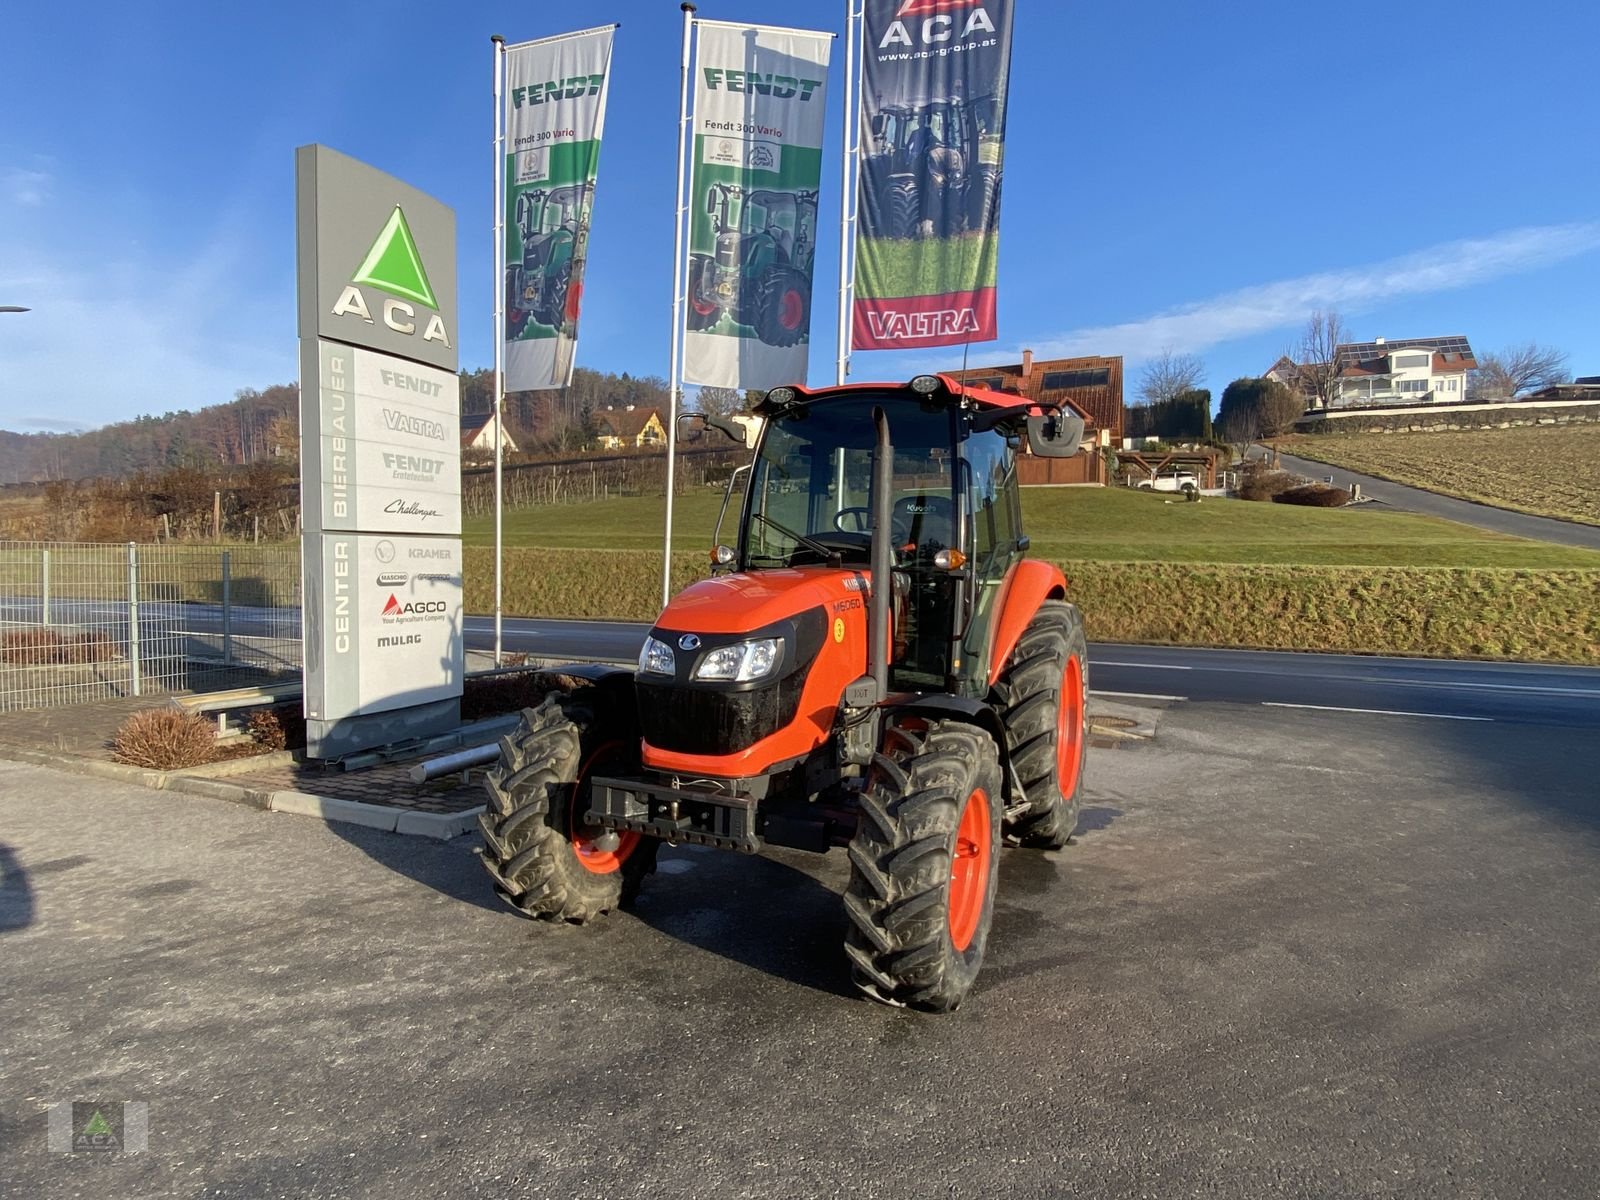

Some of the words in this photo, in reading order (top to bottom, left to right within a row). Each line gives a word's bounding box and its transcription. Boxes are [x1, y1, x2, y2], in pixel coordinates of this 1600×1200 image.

[878, 7, 996, 49] ACA
[511, 74, 606, 110] FENDT
[703, 67, 823, 102] FENDT
[514, 133, 535, 147] Fendt
[536, 131, 551, 142] 300
[552, 127, 575, 139] Vario
[704, 119, 734, 132] Fendt
[736, 122, 755, 134] 300
[757, 124, 783, 139] Vario
[331, 285, 452, 349] ACA
[867, 308, 980, 340] VALTRA
[380, 369, 443, 397] FENDT
[331, 356, 347, 518] BIERBAUER
[383, 409, 445, 441] VALTRA
[382, 452, 445, 474] FENDT
[383, 499, 445, 520] Challenger
[408, 548, 451, 560] KRAMER
[335, 541, 350, 654] CENTER
[403, 601, 447, 614] AGCO
[377, 634, 422, 648] MULAG
